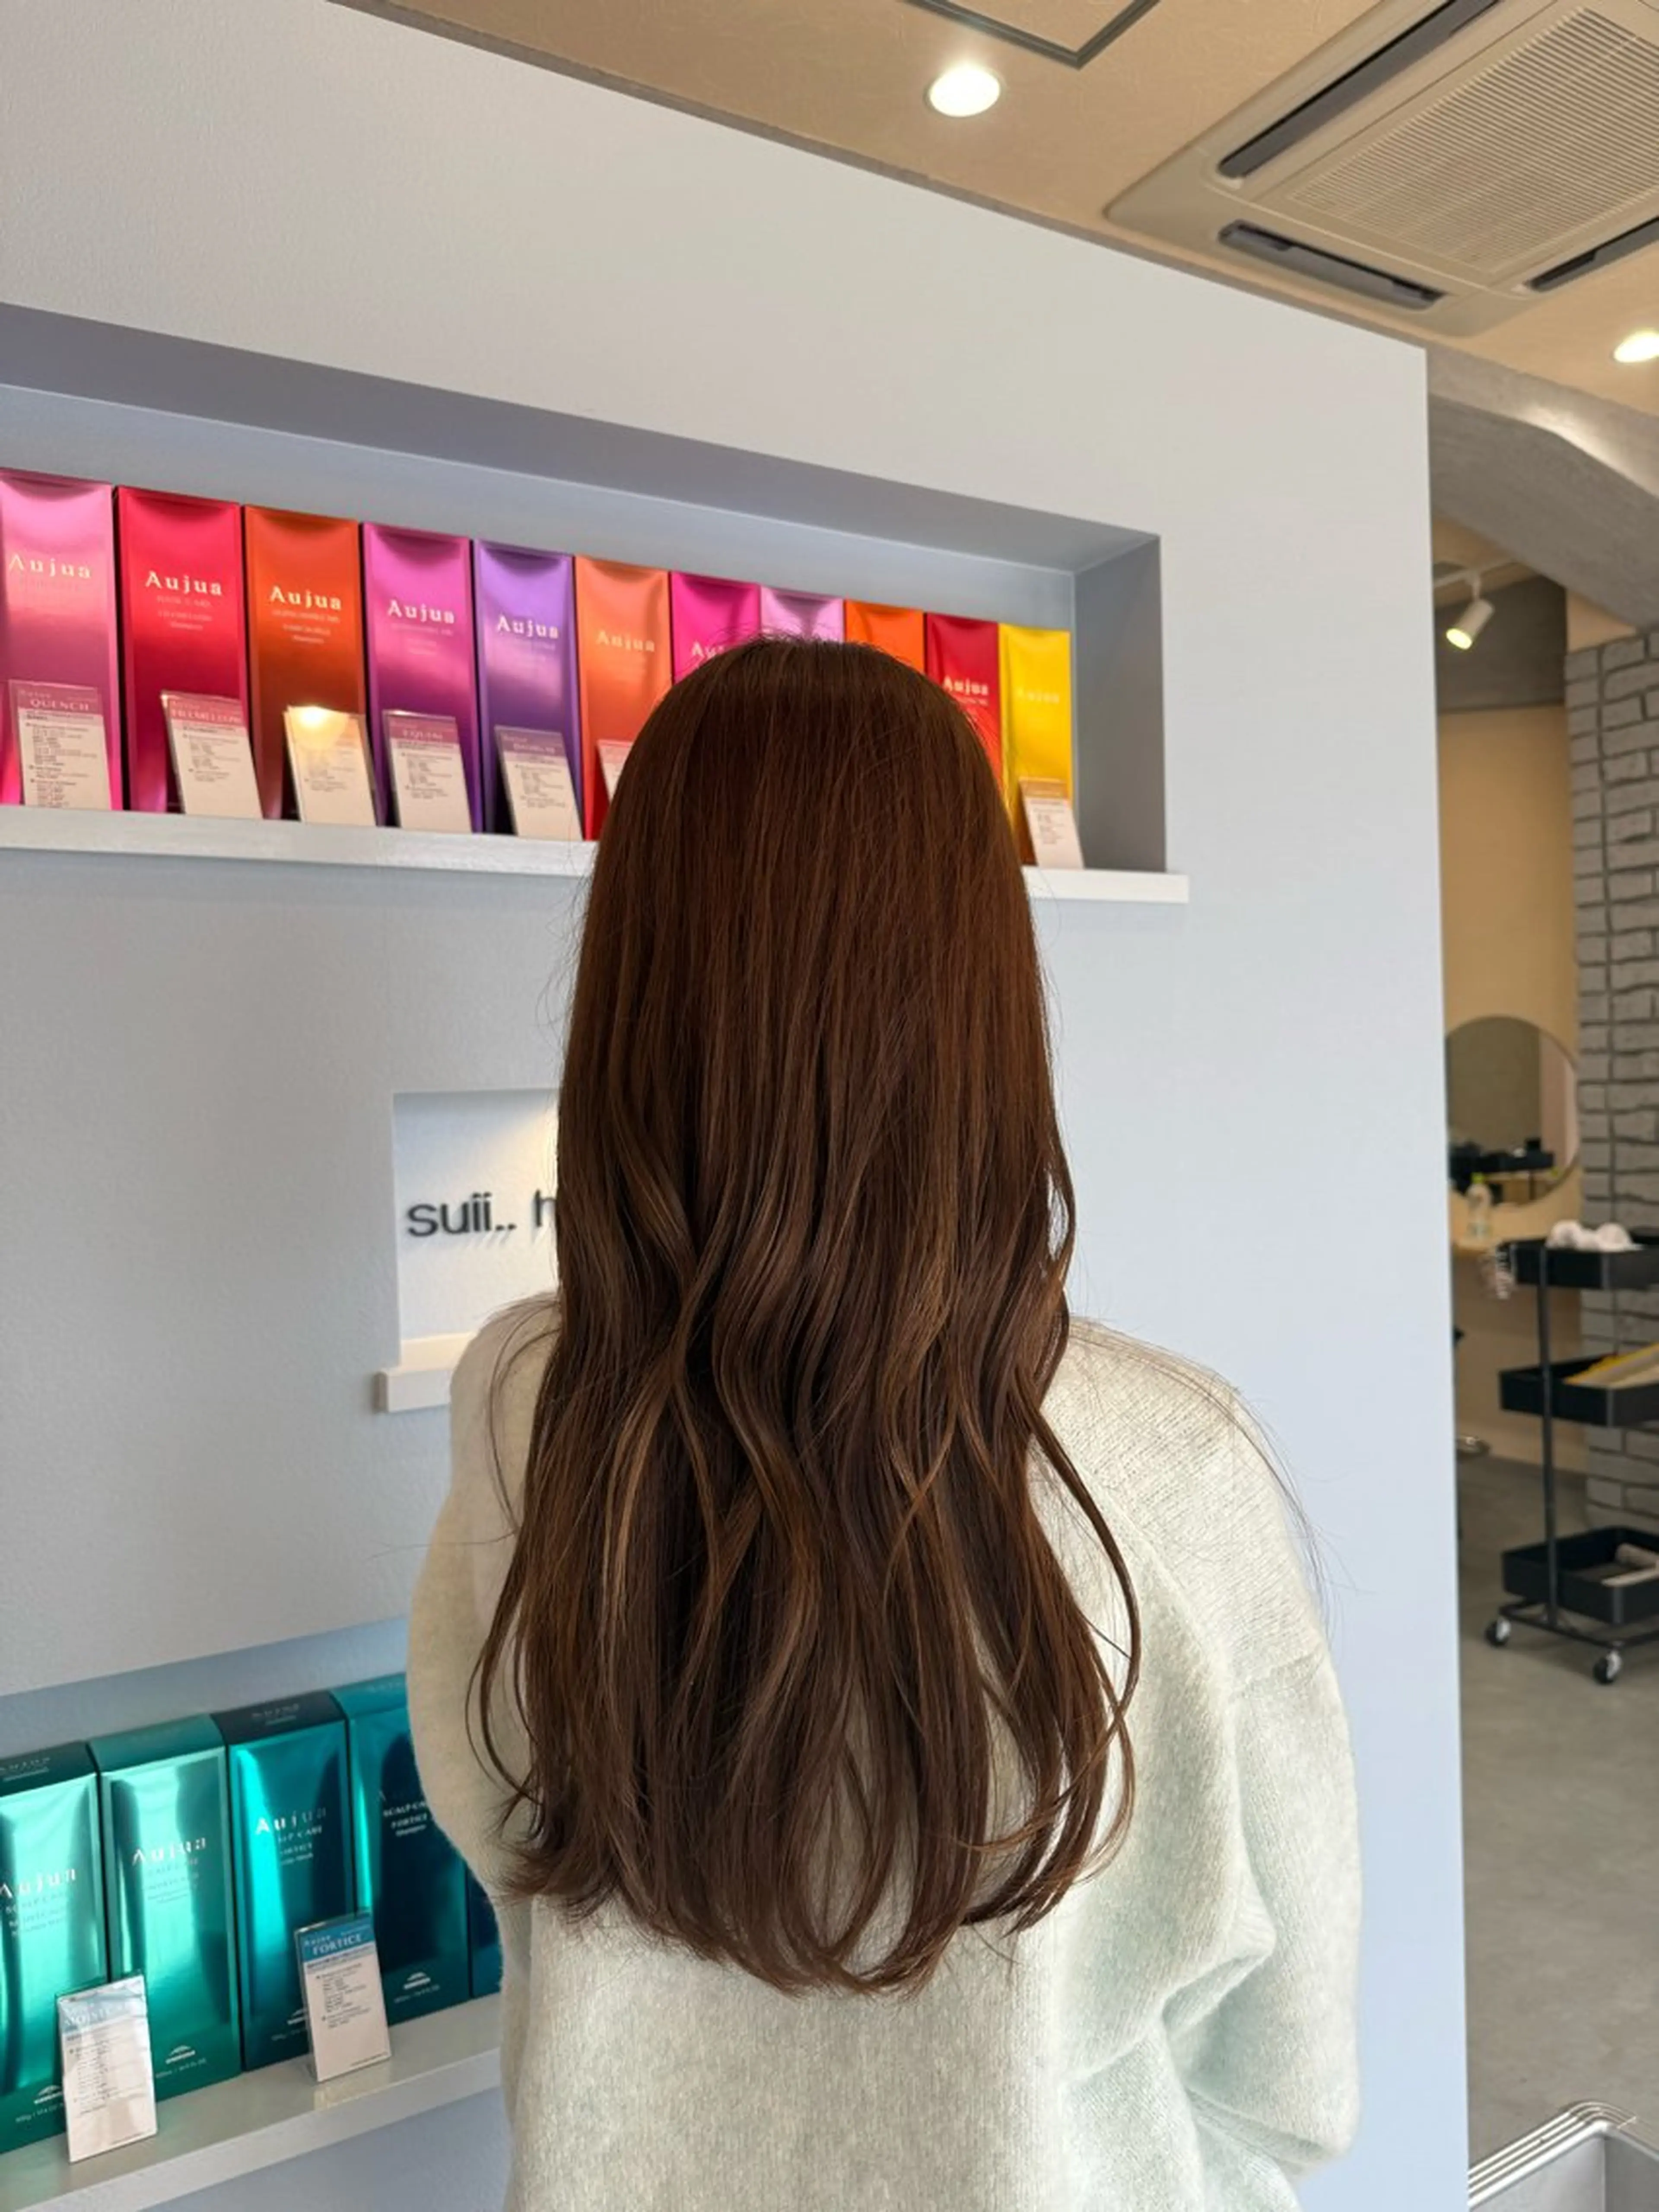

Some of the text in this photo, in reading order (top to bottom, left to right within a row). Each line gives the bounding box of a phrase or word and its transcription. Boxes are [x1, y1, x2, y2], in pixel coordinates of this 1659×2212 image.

[9, 553, 92, 579] Aujua
[145, 570, 222, 596] Aujua
[270, 585, 342, 611] Aujua
[388, 599, 455, 624] Aujua
[496, 615, 559, 639] Aujua
[595, 629, 655, 653] Aujua
[29, 698, 90, 711] QUENCH
[407, 1191, 518, 1238] suii..
[255, 1807, 327, 1835] Aujua
[132, 1837, 206, 1867] Aujua
